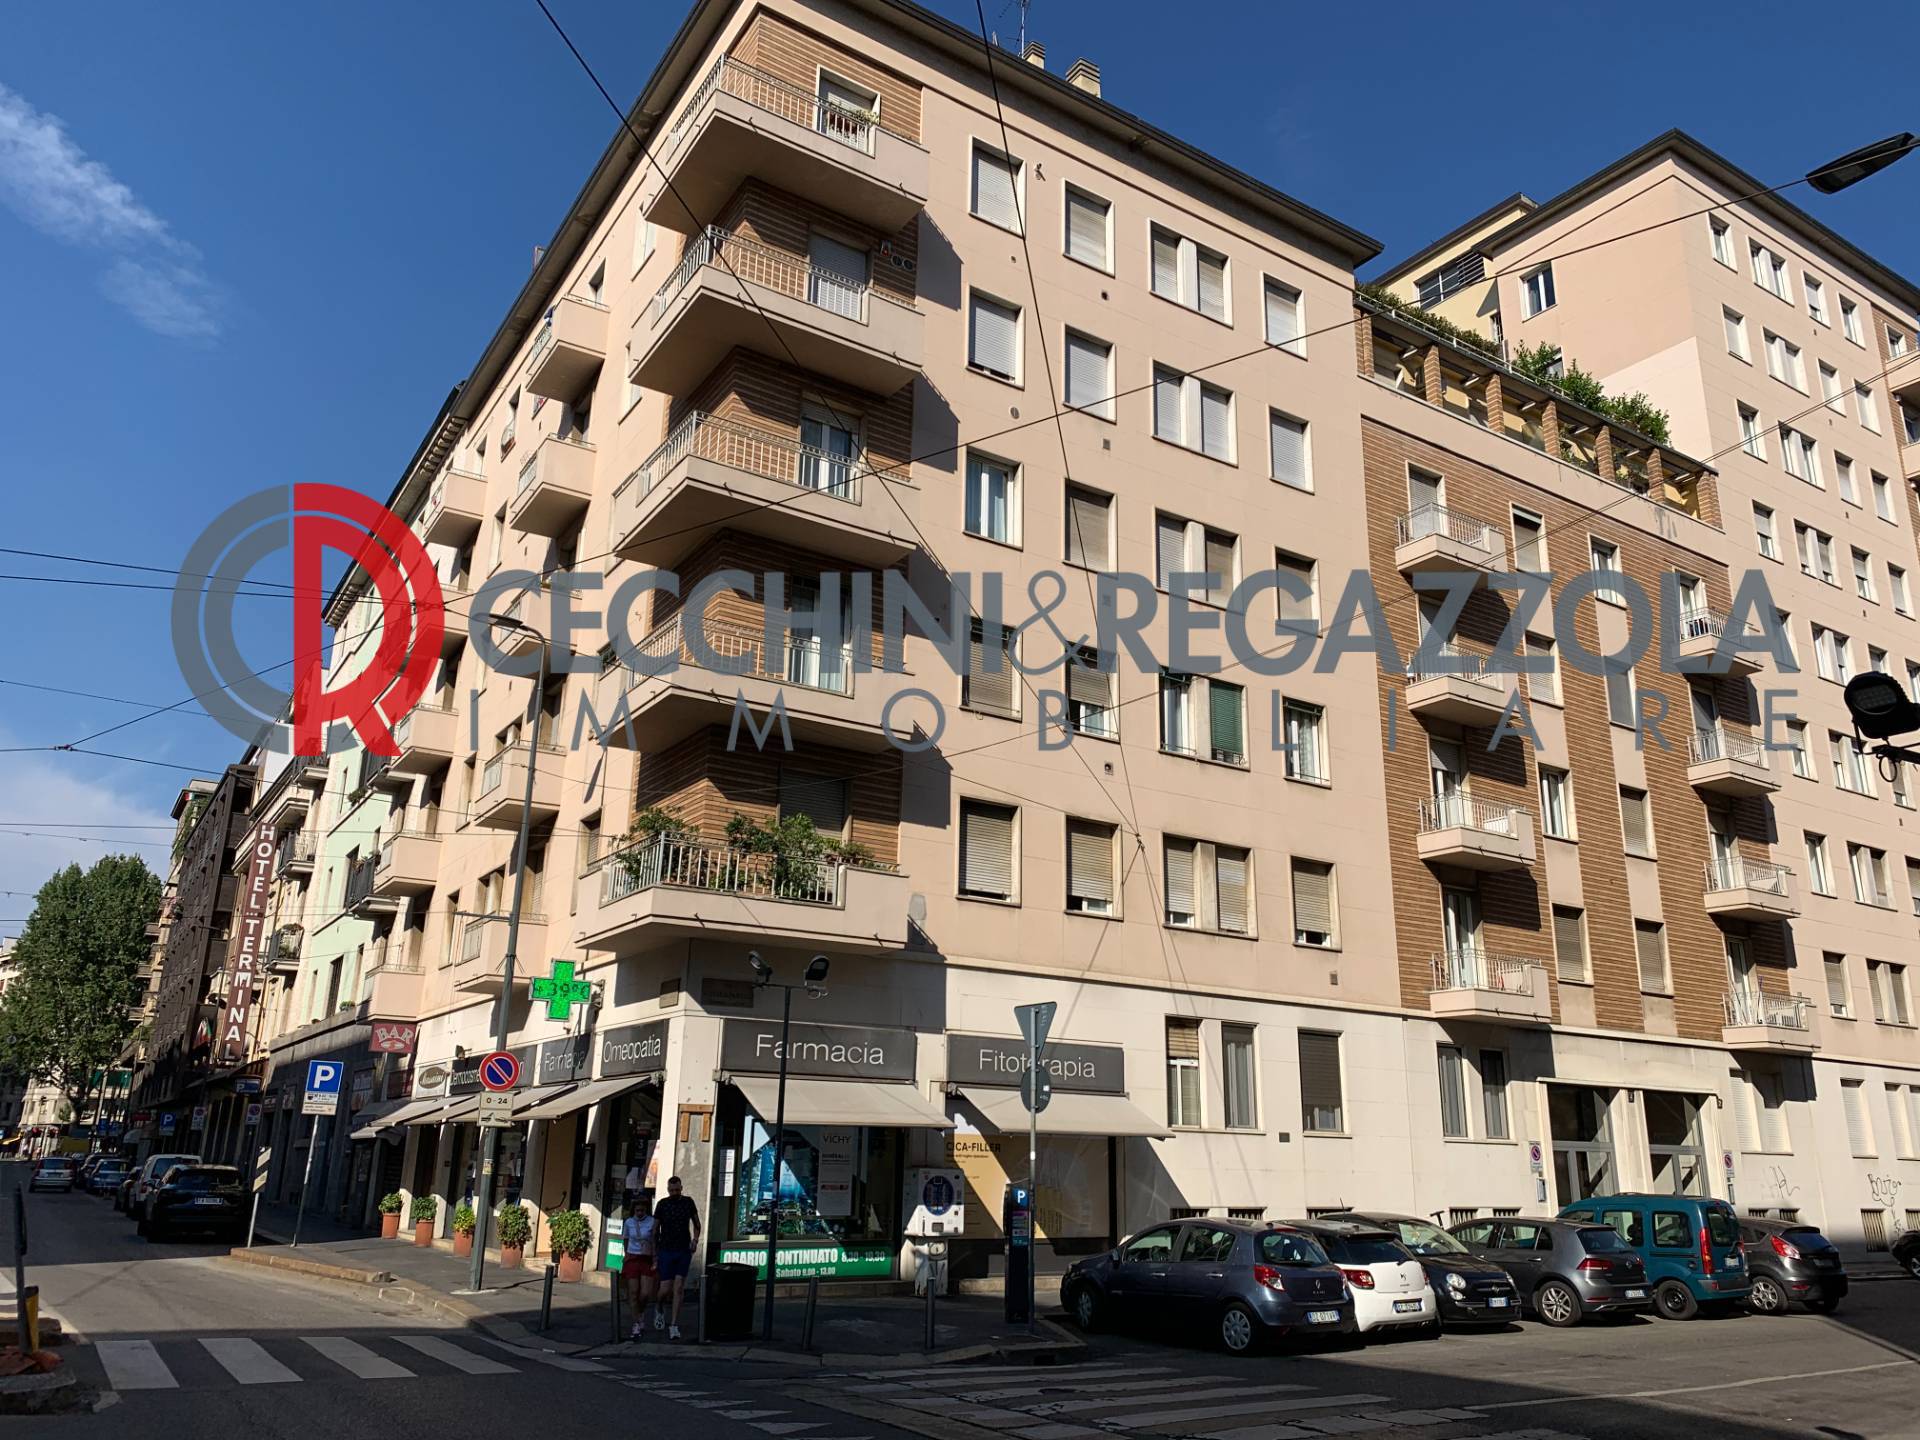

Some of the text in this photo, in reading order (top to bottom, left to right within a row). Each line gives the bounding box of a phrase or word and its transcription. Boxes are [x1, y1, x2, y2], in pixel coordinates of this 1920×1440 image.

[250, 824, 275, 910] HOTEL
[224, 919, 260, 1060] TERMINAL
[375, 1025, 414, 1045] BAR
[603, 1034, 661, 1063] Omeopatia
[757, 1034, 884, 1065] Farmacia
[313, 1065, 335, 1088] P
[497, 1097, 508, 1105] 24
[162, 1114, 173, 1125] P
[823, 1135, 851, 1145] VICHY
[1017, 1190, 1026, 1204] P
[775, 1248, 838, 1265] ONTINUATO
[775, 1268, 801, 1278] Sabato
